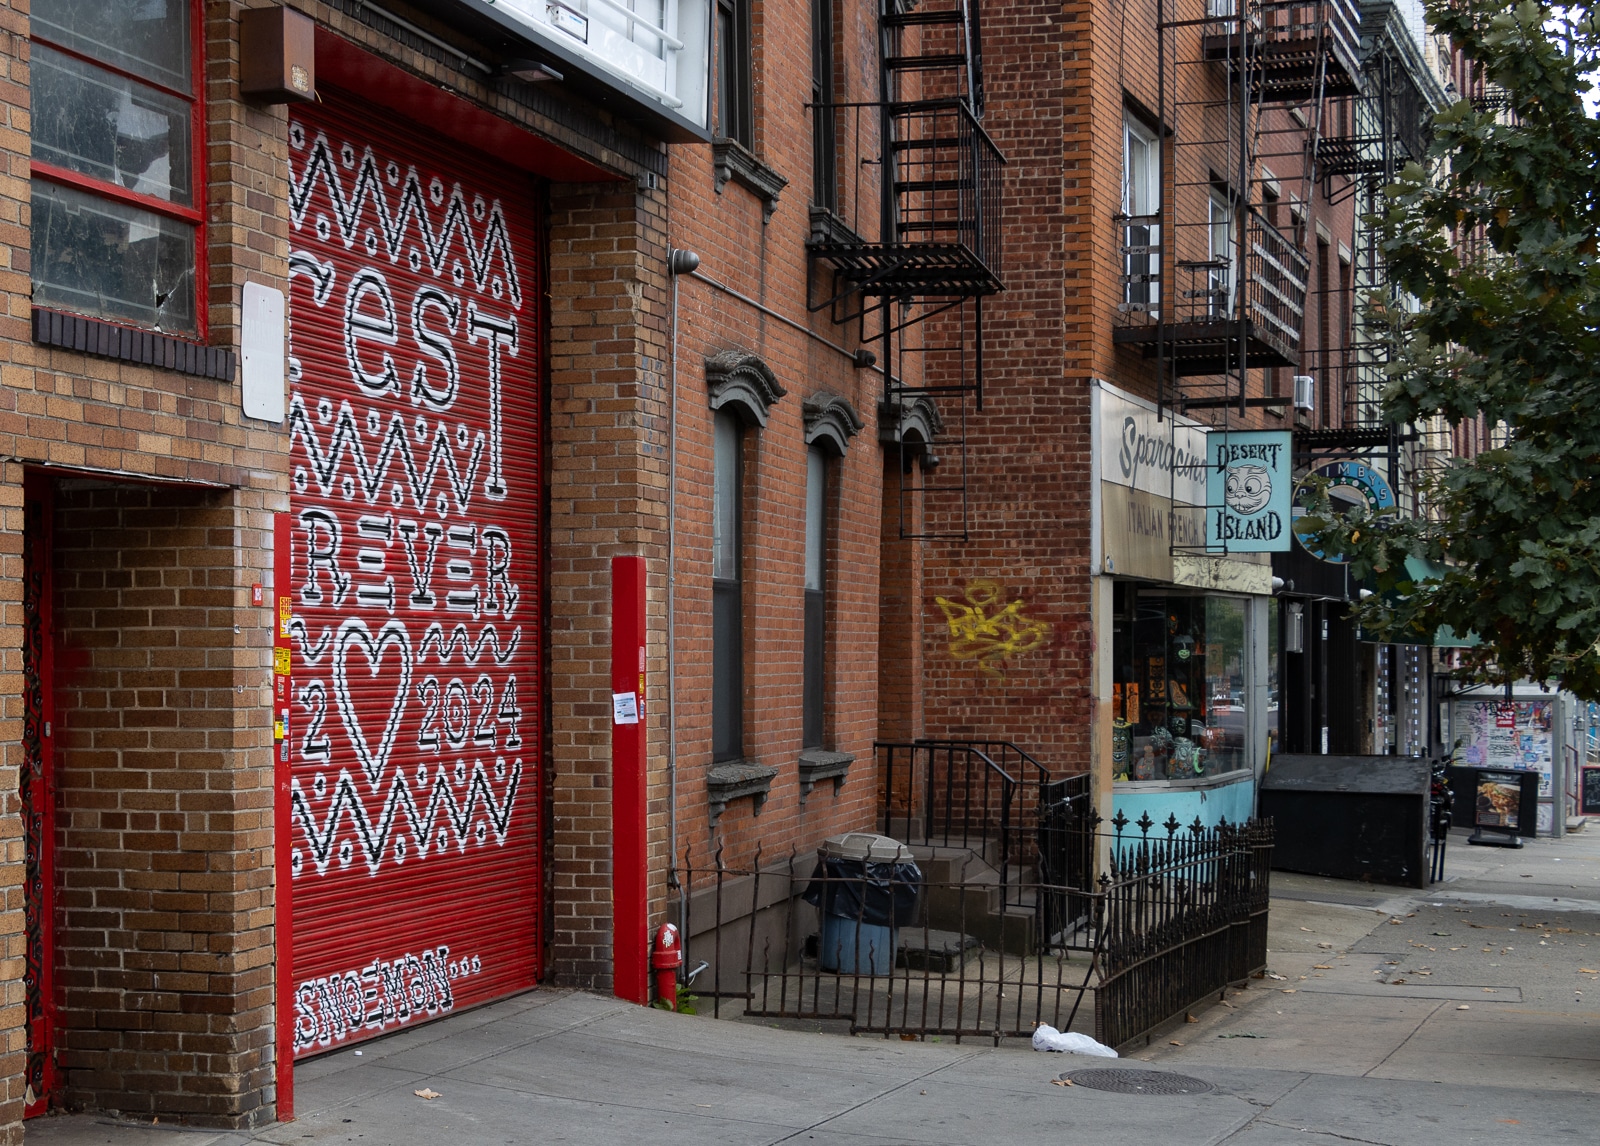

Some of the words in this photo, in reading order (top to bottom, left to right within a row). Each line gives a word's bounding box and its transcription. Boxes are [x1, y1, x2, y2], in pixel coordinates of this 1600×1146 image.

[1216, 444, 1282, 474] DESERT
[1128, 501, 1164, 539] ITALIAN
[1168, 512, 1198, 546] FRENCH
[1215, 510, 1282, 541] ISLAND
